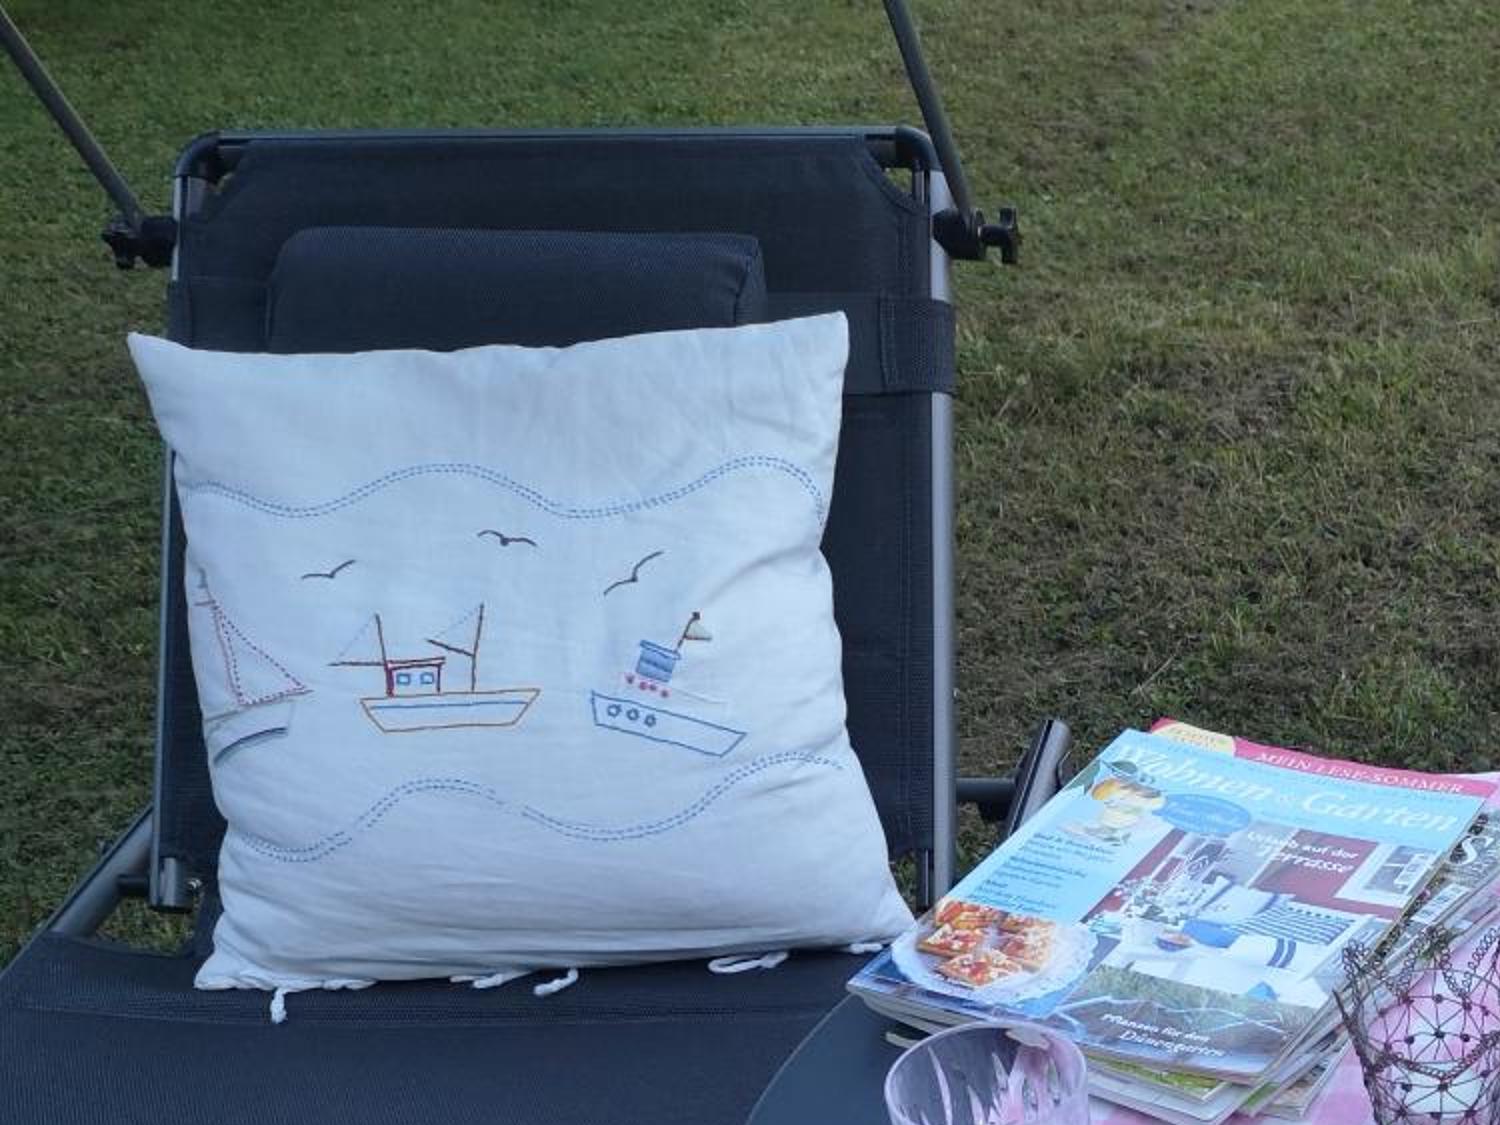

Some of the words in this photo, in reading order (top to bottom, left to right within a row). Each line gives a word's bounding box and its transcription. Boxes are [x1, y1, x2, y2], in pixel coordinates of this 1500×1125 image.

[1118, 747, 1274, 801] Wohnen
[1302, 791, 1457, 833] Garten
[1256, 846, 1355, 873] Terrasse
[1301, 844, 1329, 856] auf
[1330, 848, 1360, 860] der
[1100, 1013, 1160, 1033] Pflanzen
[1184, 1030, 1211, 1043] den
